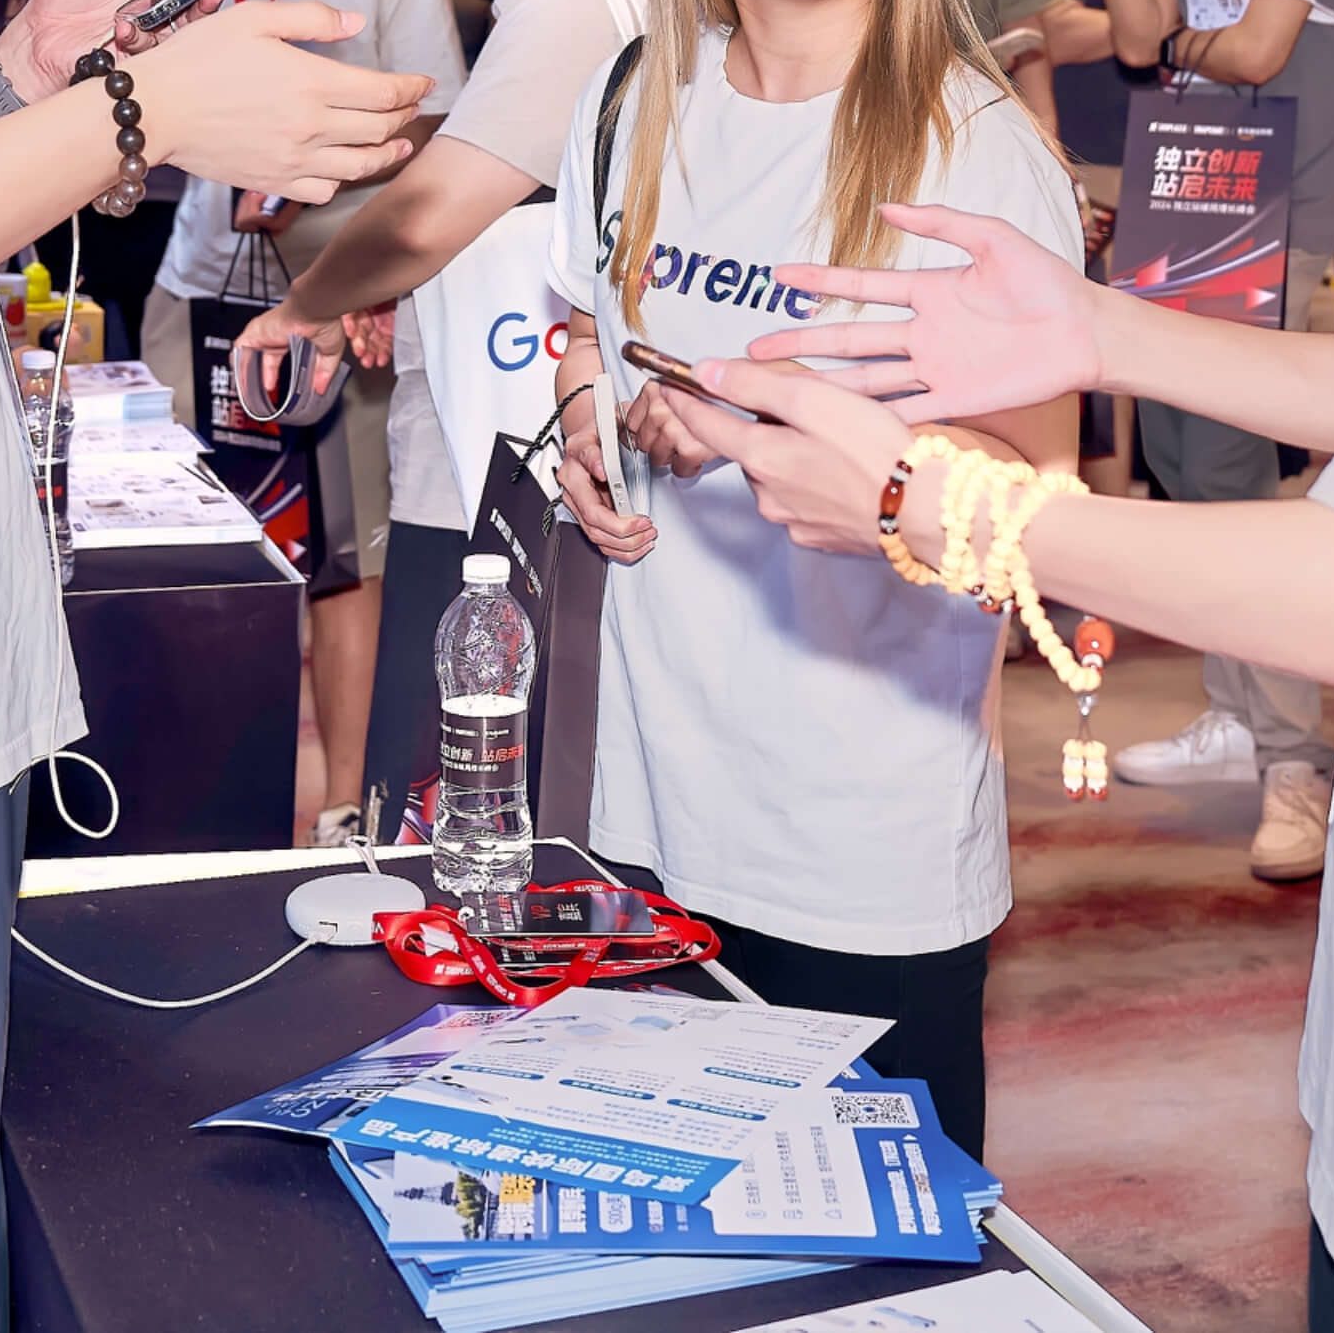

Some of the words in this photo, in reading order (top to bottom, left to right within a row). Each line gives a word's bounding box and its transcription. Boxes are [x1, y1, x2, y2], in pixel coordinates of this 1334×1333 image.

[1154, 146, 1263, 174] 独立创新
[1150, 172, 1259, 201] 站启未来
